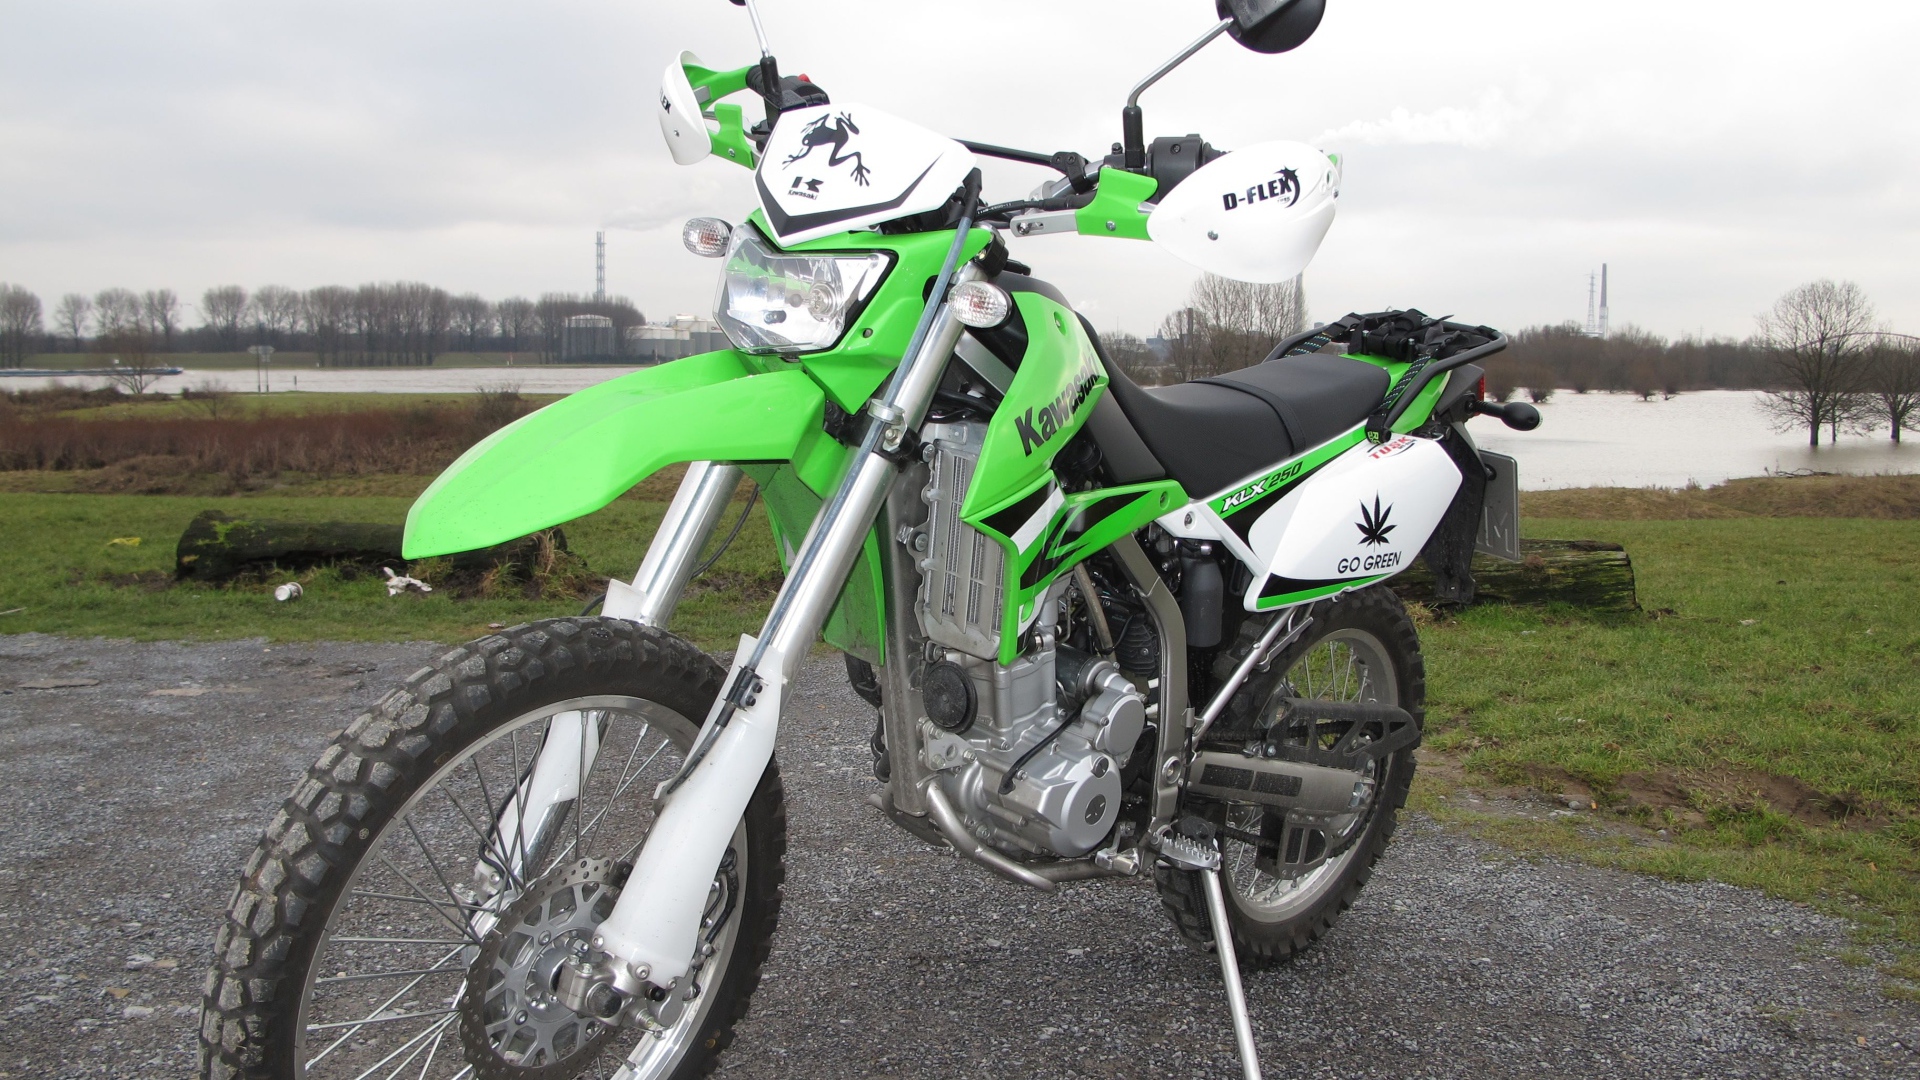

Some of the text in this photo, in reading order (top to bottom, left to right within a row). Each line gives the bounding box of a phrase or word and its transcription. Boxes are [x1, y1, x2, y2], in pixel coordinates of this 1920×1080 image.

[1368, 436, 1411, 460] TUSK
[1220, 461, 1304, 514] KLX 250
[1337, 550, 1402, 574] GO GREEN
